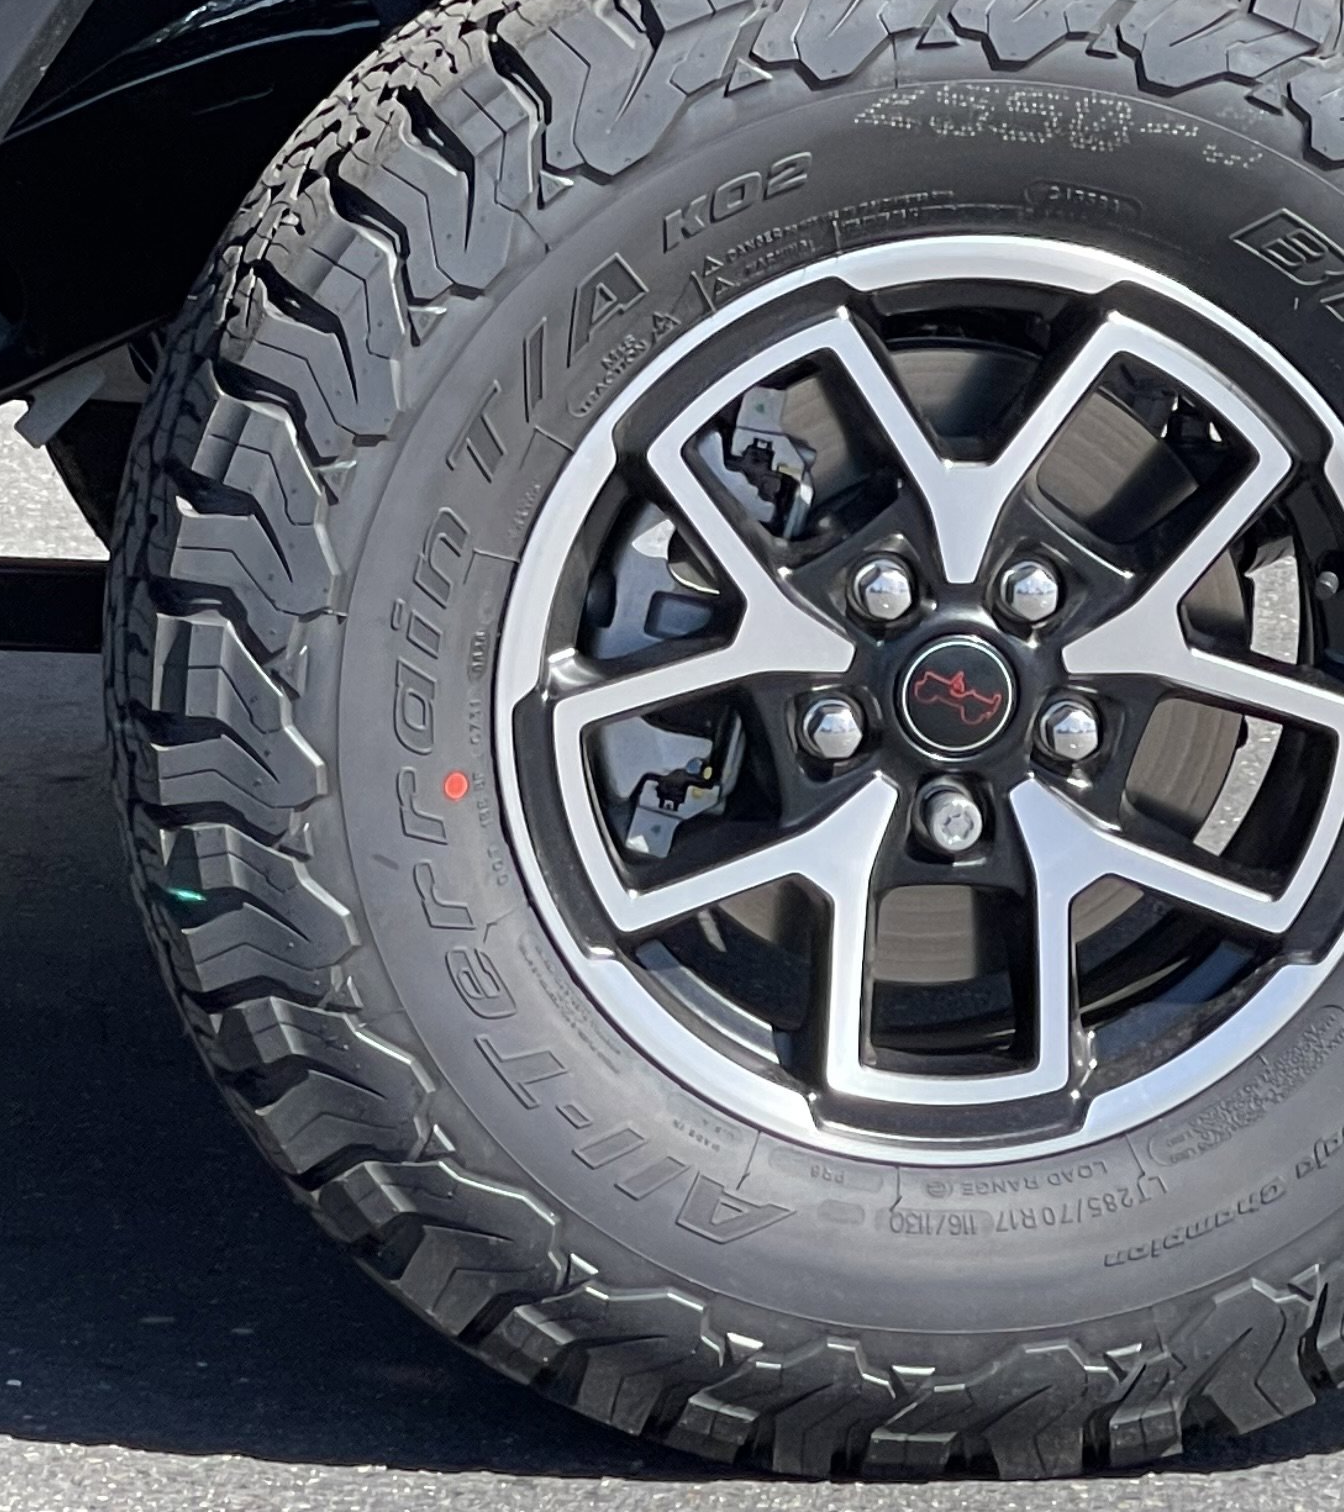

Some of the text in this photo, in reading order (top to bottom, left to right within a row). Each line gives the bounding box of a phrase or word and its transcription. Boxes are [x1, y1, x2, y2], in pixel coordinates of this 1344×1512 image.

[445, 251, 650, 484] T/A
[389, 506, 799, 1247] All-Terrain
[959, 1172, 1039, 1199] RANGE
[1044, 1155, 1110, 1191] LOAD
